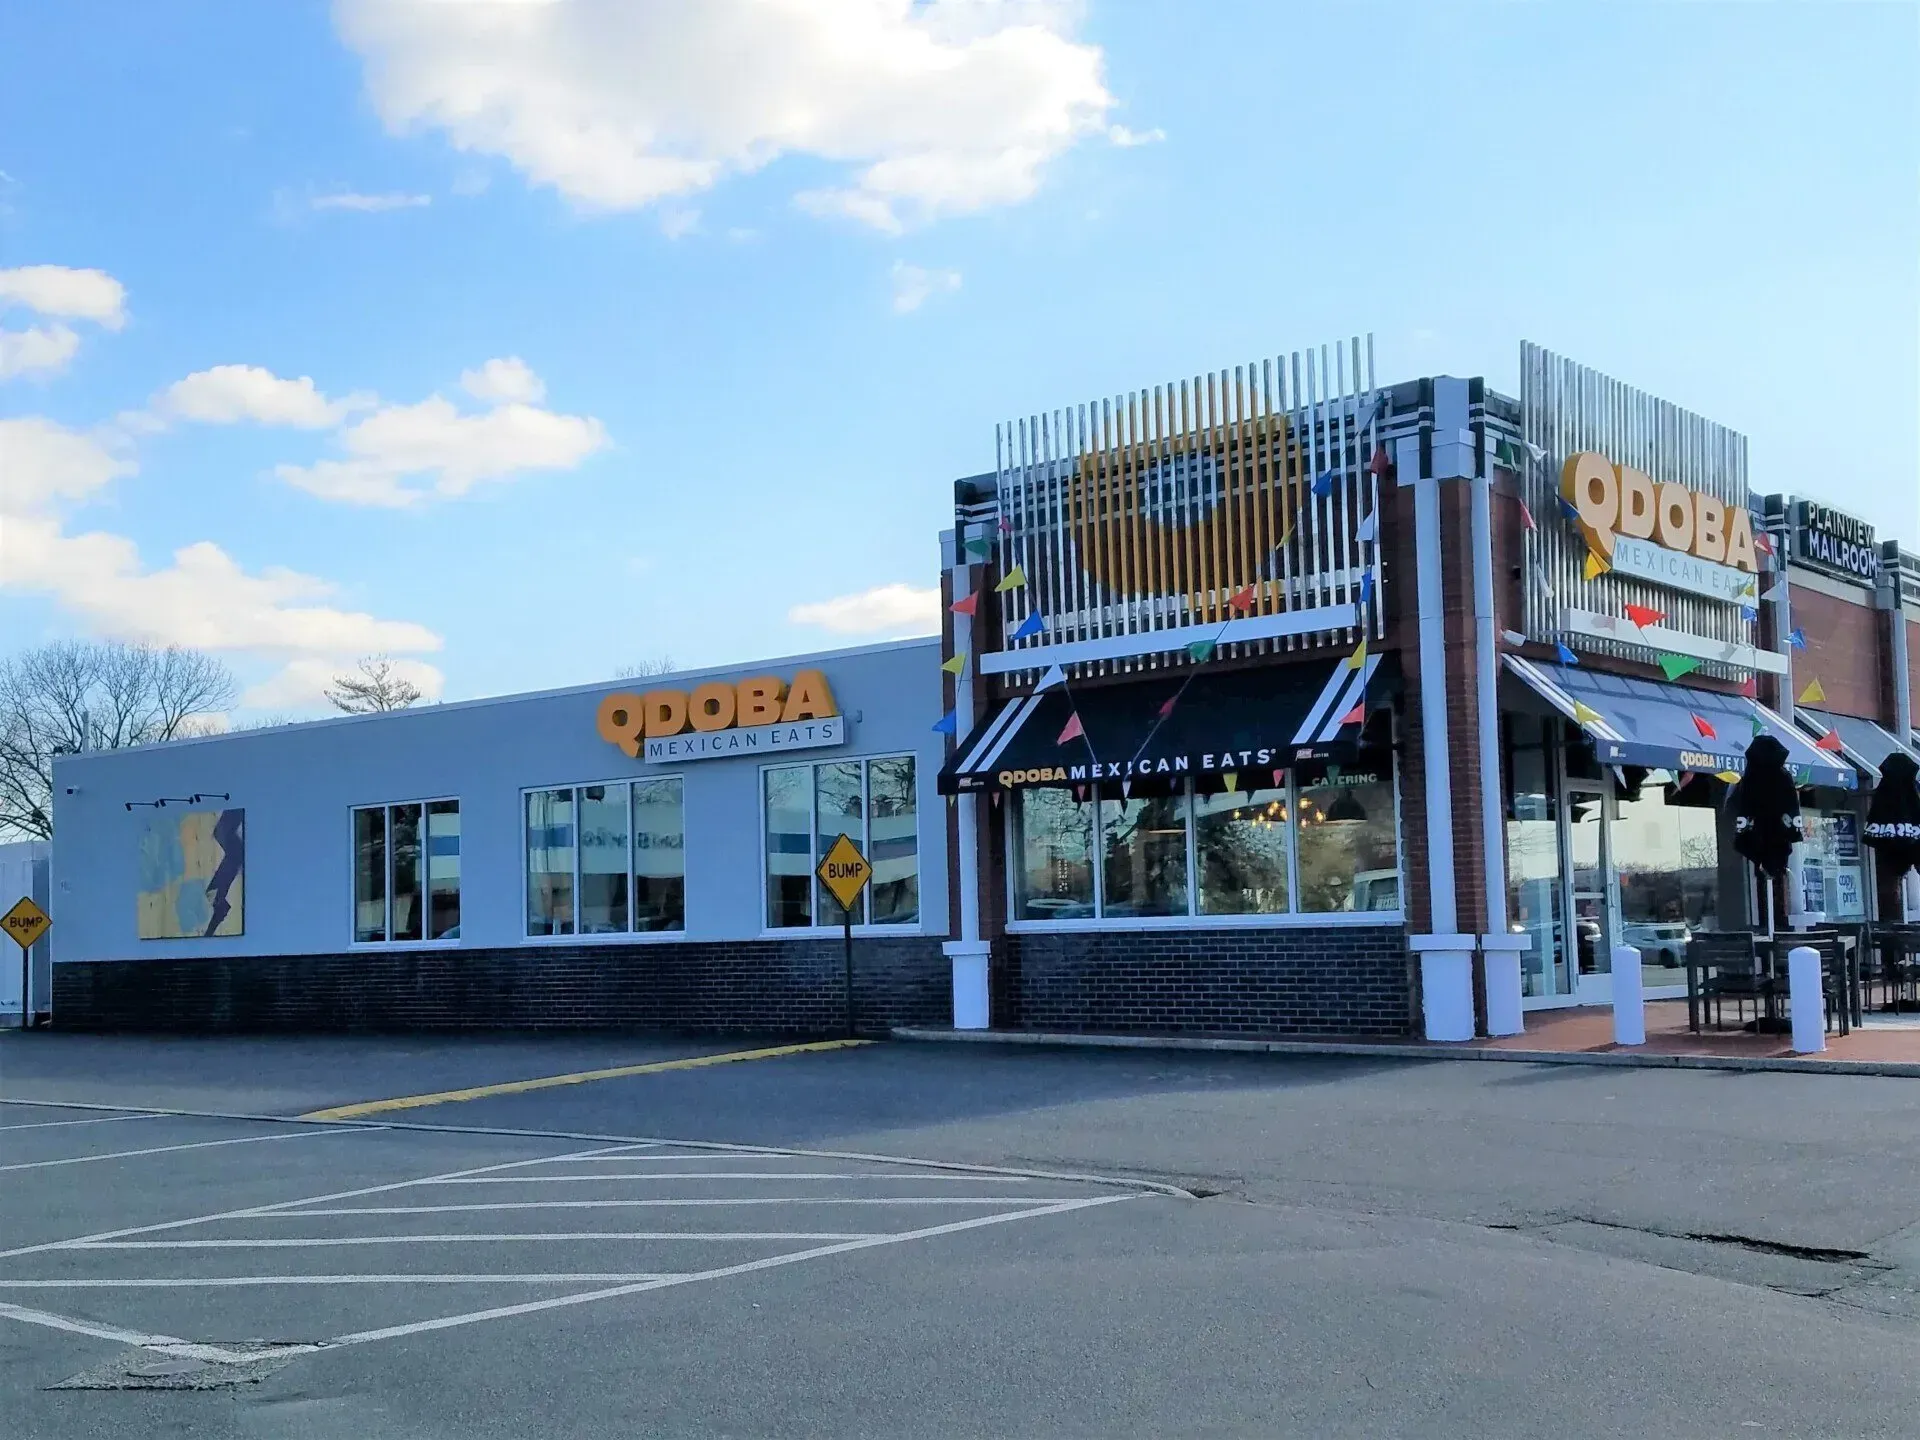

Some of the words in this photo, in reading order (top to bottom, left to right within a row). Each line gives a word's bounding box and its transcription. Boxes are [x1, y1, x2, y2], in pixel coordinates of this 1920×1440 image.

[1561, 450, 1759, 574] QDOBA
[1807, 501, 1874, 548] PLAINVIEW
[1616, 542, 1704, 584] MEXICAN
[1712, 570, 1751, 597] EAT
[1808, 528, 1878, 579] MAILROOM
[596, 668, 836, 758] QDOBA
[650, 733, 757, 757] MEXICAN
[1680, 751, 1715, 769] QDOBA
[1716, 755, 1745, 771] MEXI
[999, 767, 1067, 788] QDOBA
[1070, 755, 1189, 780] MEXICAN
[1312, 773, 1377, 786] CAERING
[828, 863, 863, 879] BUMP
[9, 916, 43, 928] BUMP
